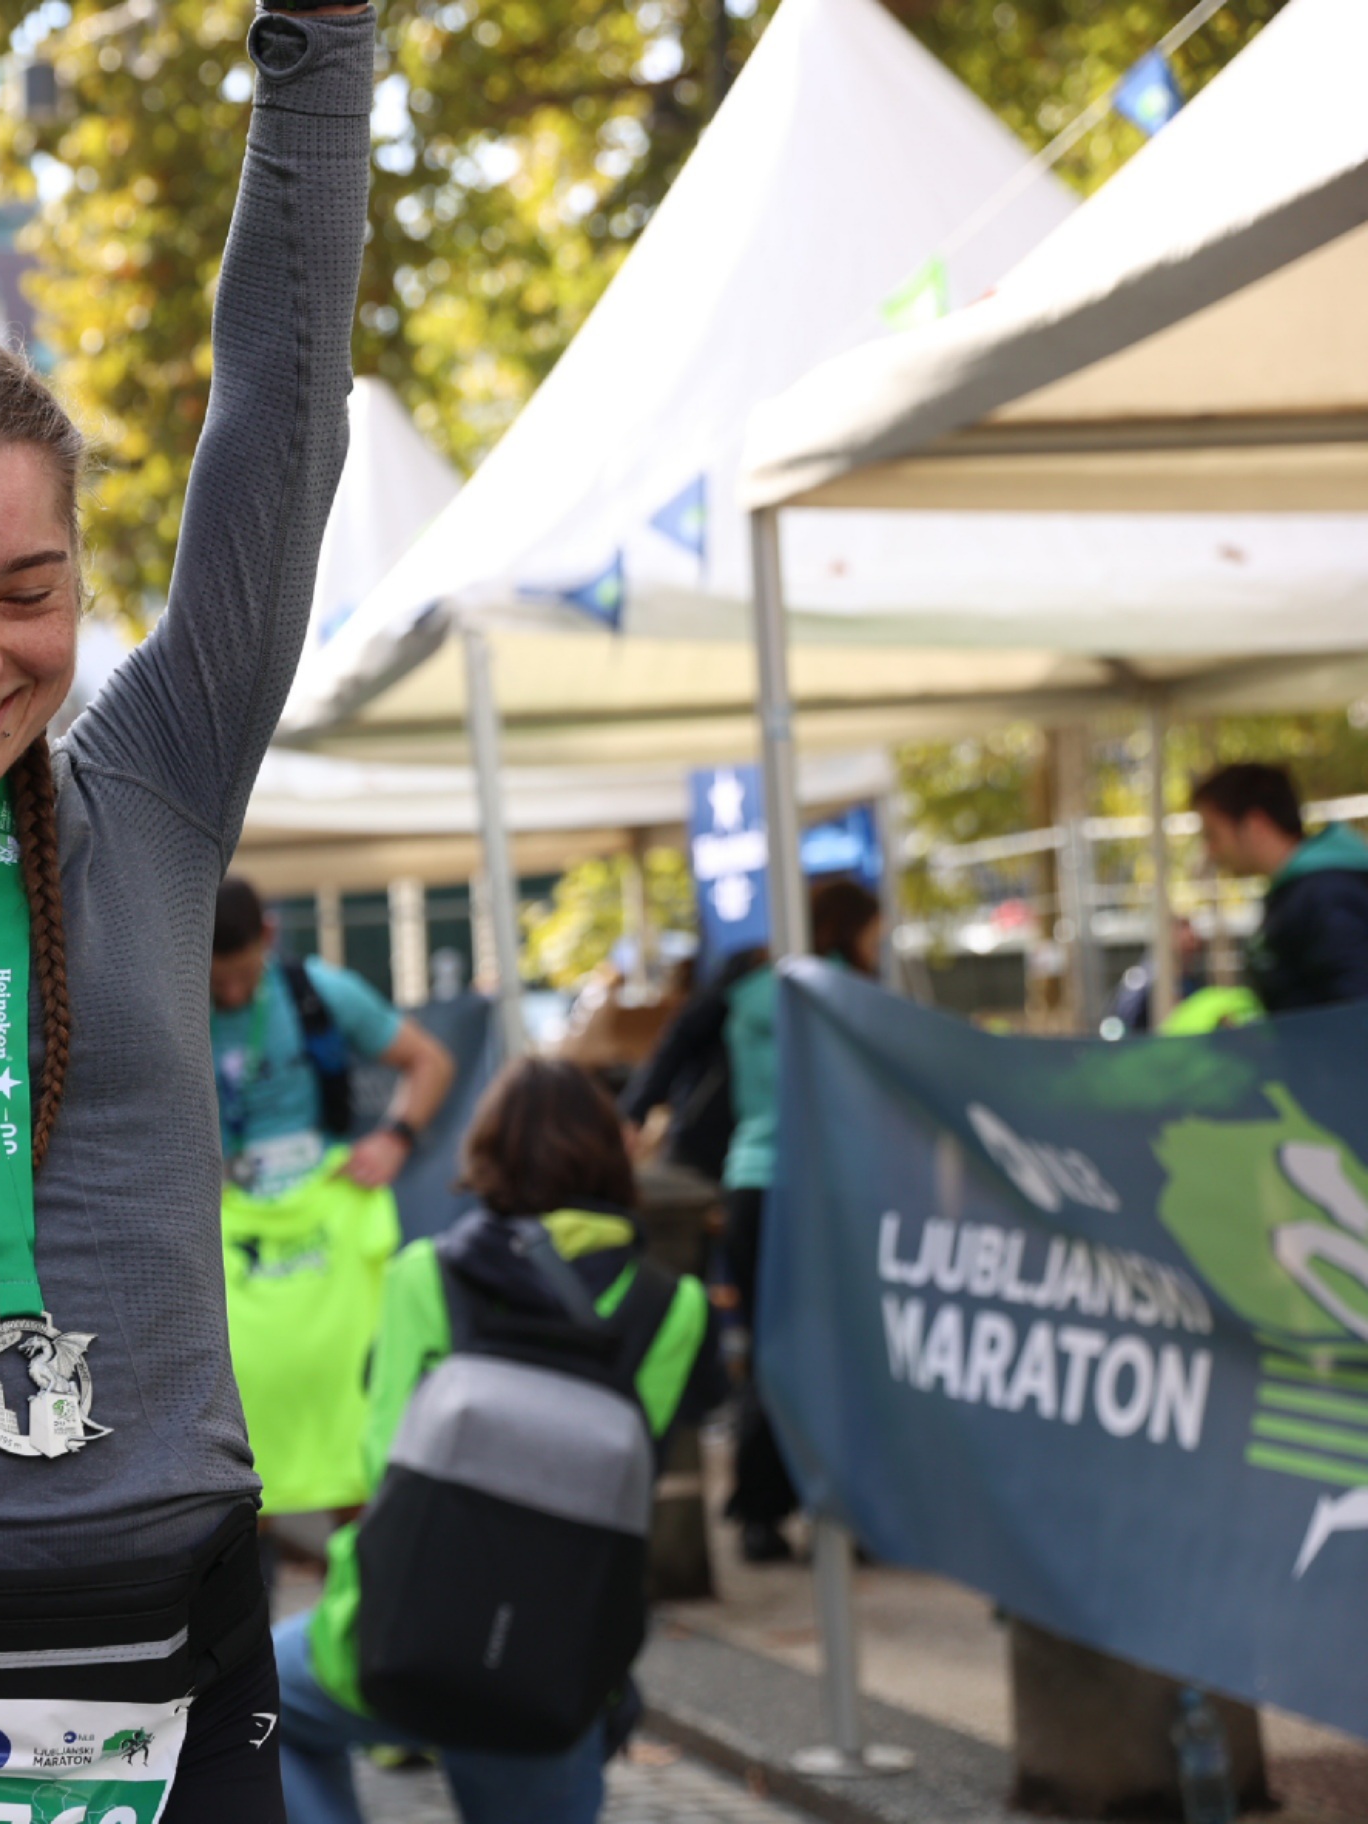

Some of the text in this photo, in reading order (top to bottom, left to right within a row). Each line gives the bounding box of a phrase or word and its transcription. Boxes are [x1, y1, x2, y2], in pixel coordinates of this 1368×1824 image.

[879, 1291, 1212, 1451] MARATON
[34, 1747, 94, 1757] LJUBLJANSKI
[33, 1755, 92, 1767] MARATON
